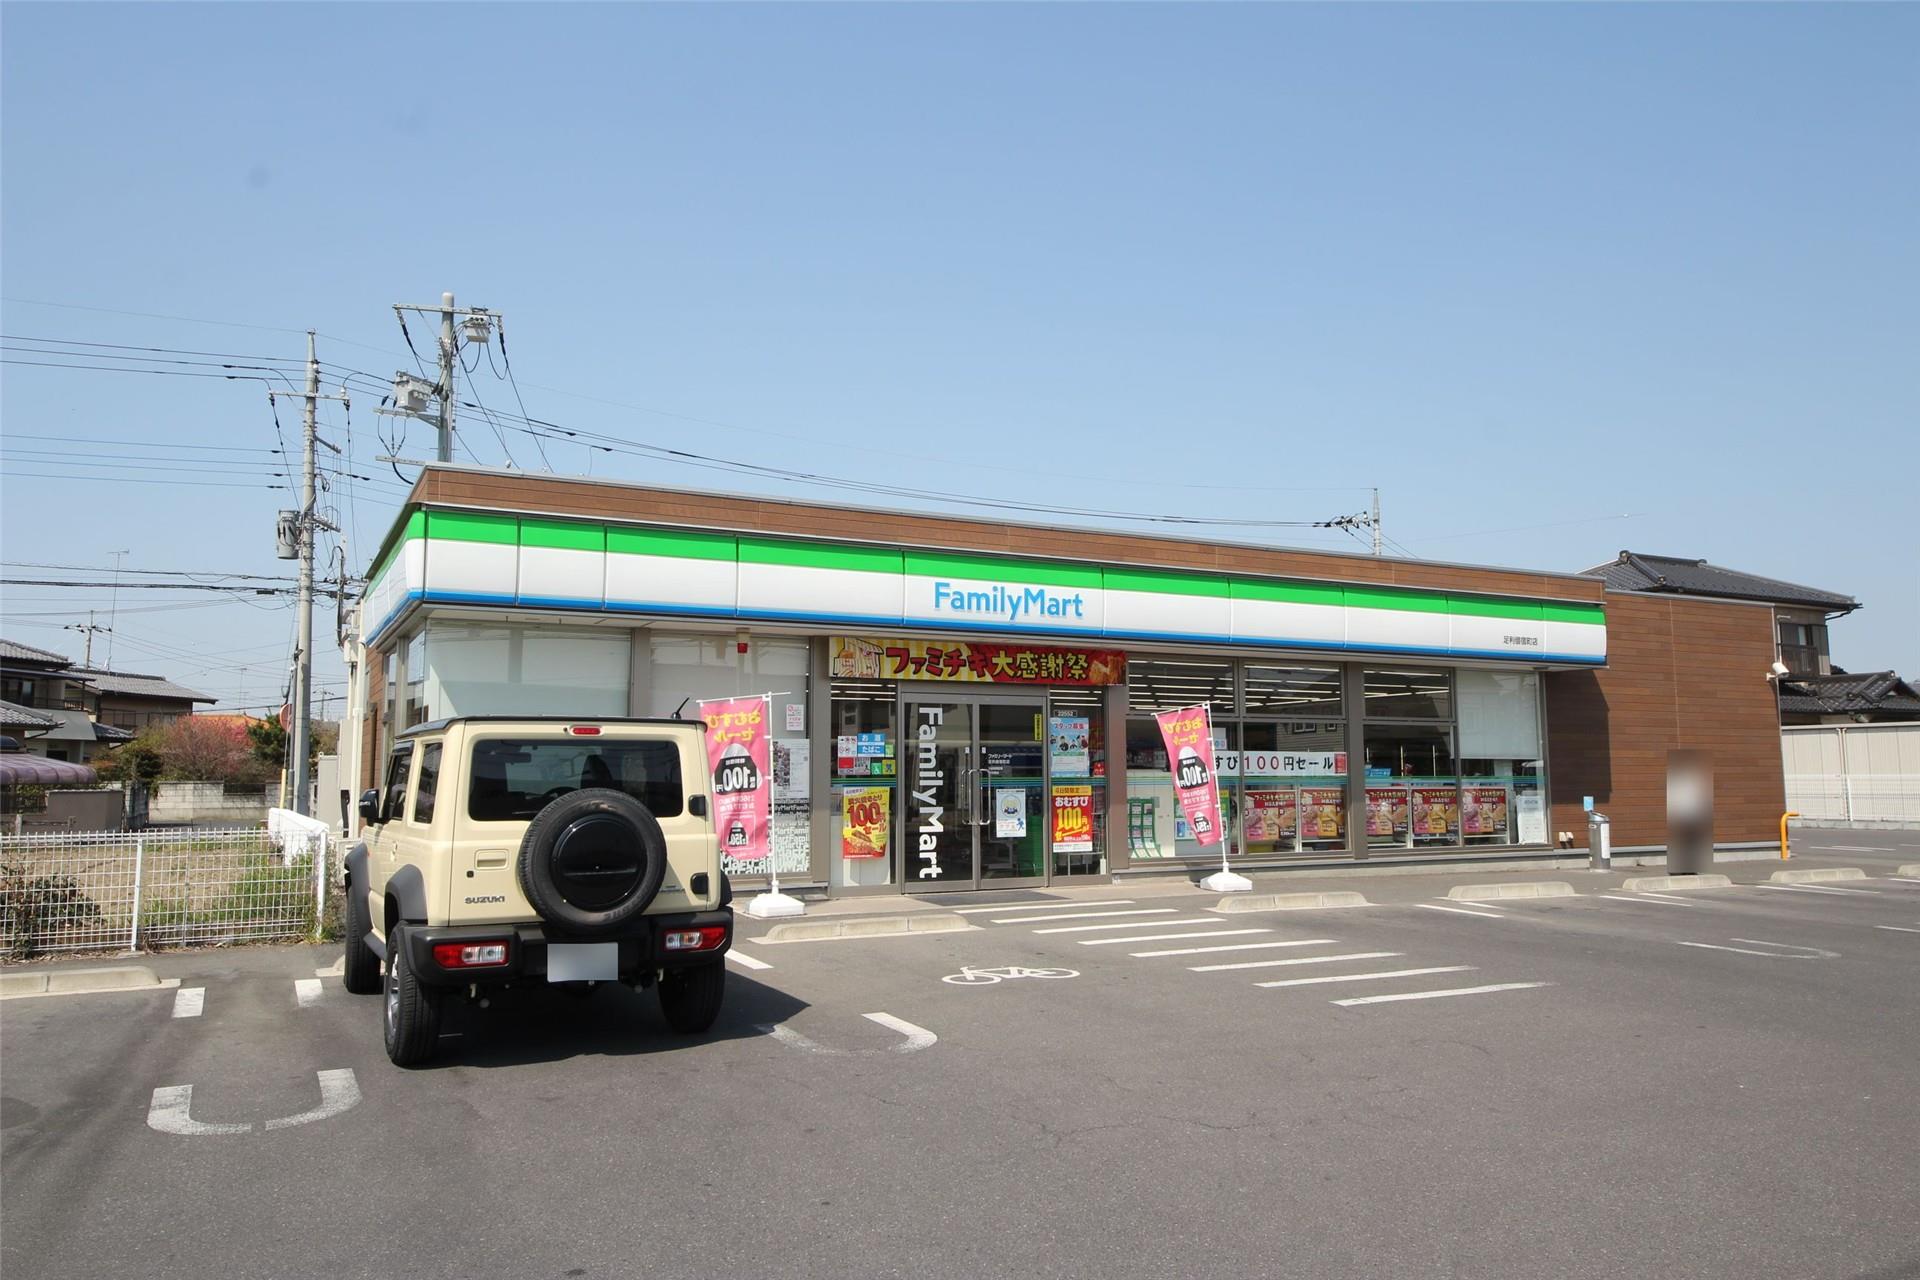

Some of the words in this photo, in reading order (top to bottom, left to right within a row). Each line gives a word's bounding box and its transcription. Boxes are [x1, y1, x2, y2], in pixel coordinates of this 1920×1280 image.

[934, 581, 1084, 621] FamilyMart
[885, 647, 1090, 681] ファミチキ大感謝祭
[912, 707, 945, 879] FamilyMart
[1055, 796, 1089, 807] おむすび
[465, 896, 505, 904] SUZUKI
